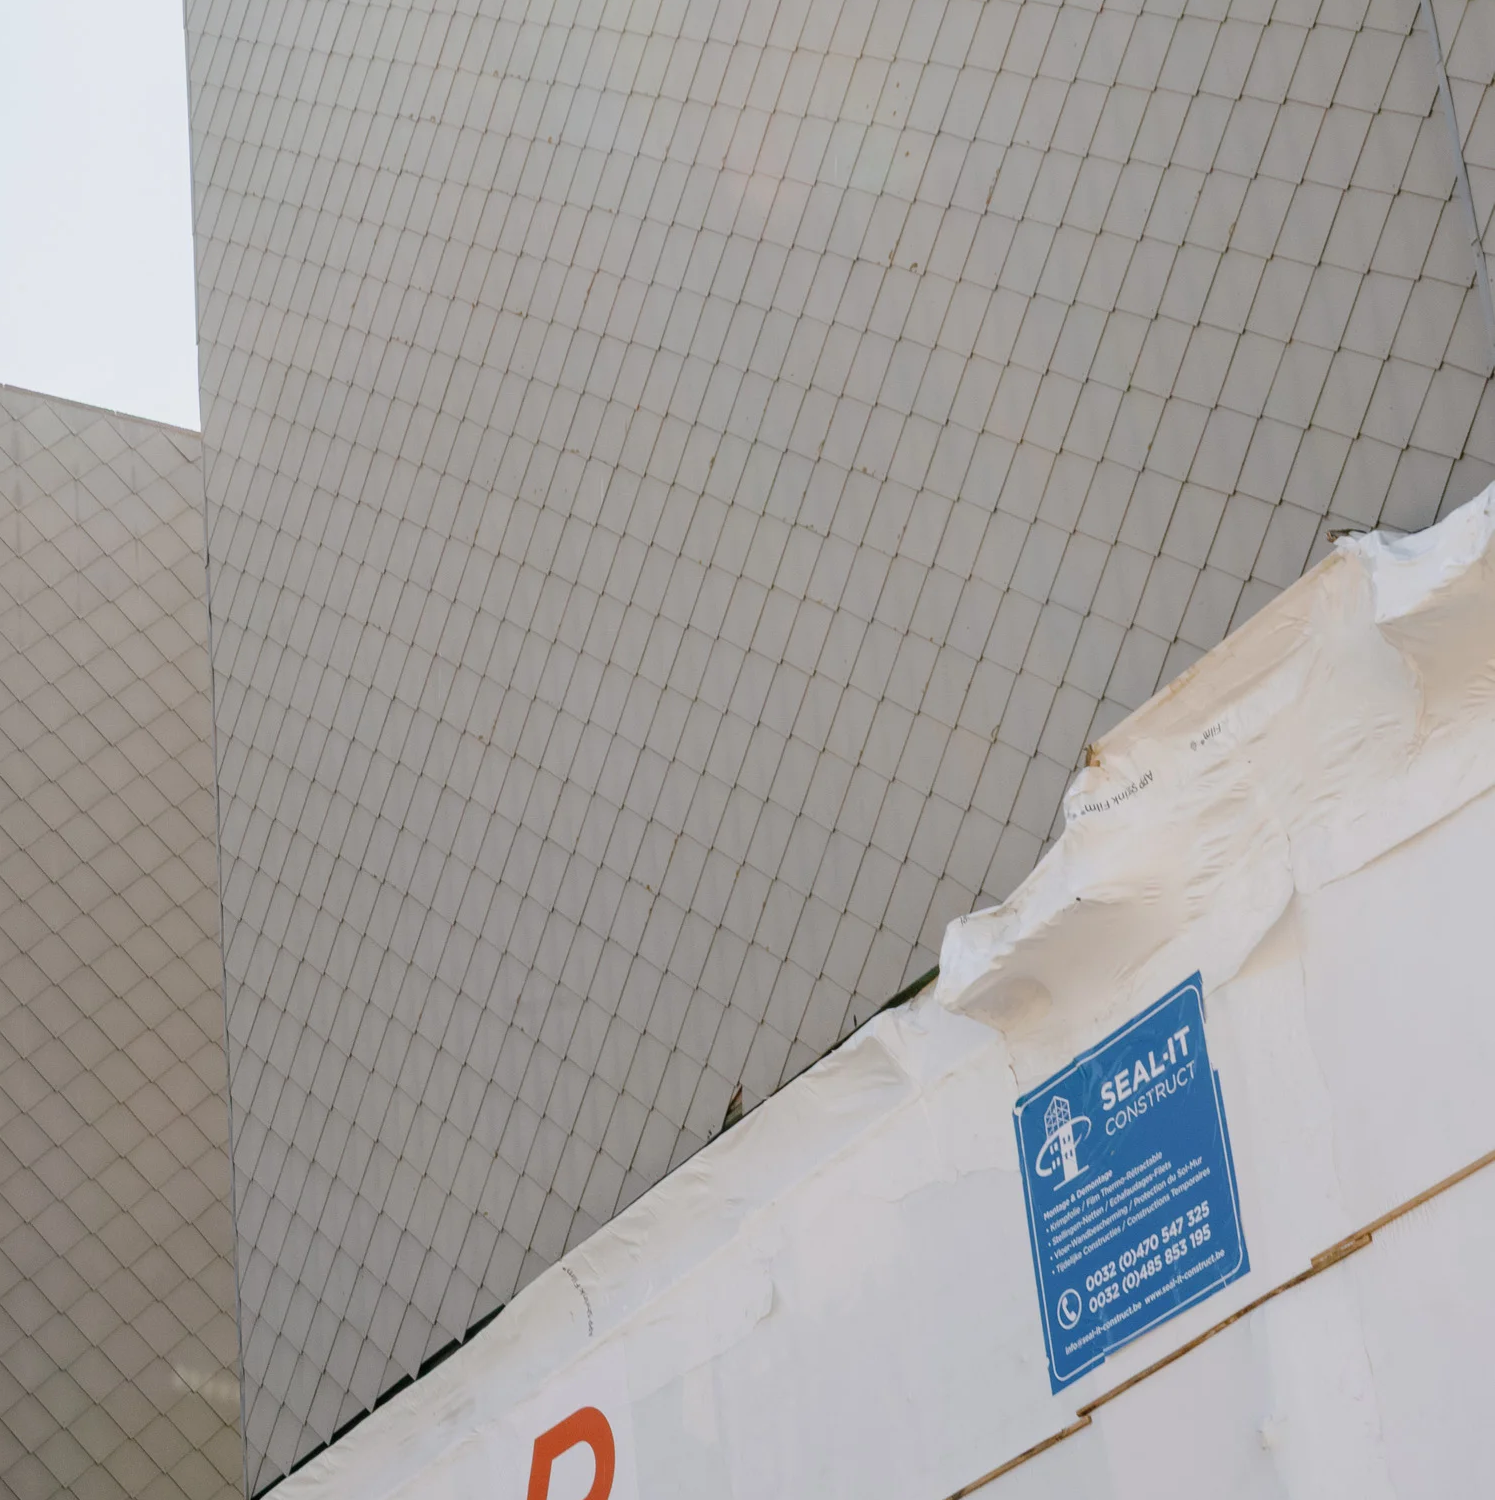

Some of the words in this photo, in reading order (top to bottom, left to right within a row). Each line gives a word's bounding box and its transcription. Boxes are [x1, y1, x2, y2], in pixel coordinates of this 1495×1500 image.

[1100, 1025, 1191, 1111] SEAL-IT
[1106, 1060, 1196, 1137] CONSTRUCT
[1044, 1199, 1070, 1221] Montage
[1049, 1206, 1081, 1232] Krimpfolie
[1086, 1193, 1100, 1208] Film
[1052, 1206, 1104, 1246] Stellingen-Netten
[1054, 1206, 1128, 1260] Vloer-Wandbescherming
[1133, 1180, 1166, 1206] Protection
[1167, 1173, 1177, 1185] du
[1056, 1250, 1083, 1273] Tijdelijke
[1083, 1226, 1121, 1255] Constructies
[1127, 1194, 1170, 1226] Constructions
[1086, 1261, 1117, 1292] 0032
[1118, 1234, 1159, 1272] (0)470
[1161, 1216, 1184, 1244] 547
[1186, 1200, 1210, 1228] 325
[1089, 1283, 1121, 1313] 0032
[1122, 1255, 1163, 1294] (0)485
[1164, 1238, 1187, 1265] 853
[1189, 1223, 1211, 1249] 195
[1144, 1249, 1225, 1305] www.seal-it-construct.be
